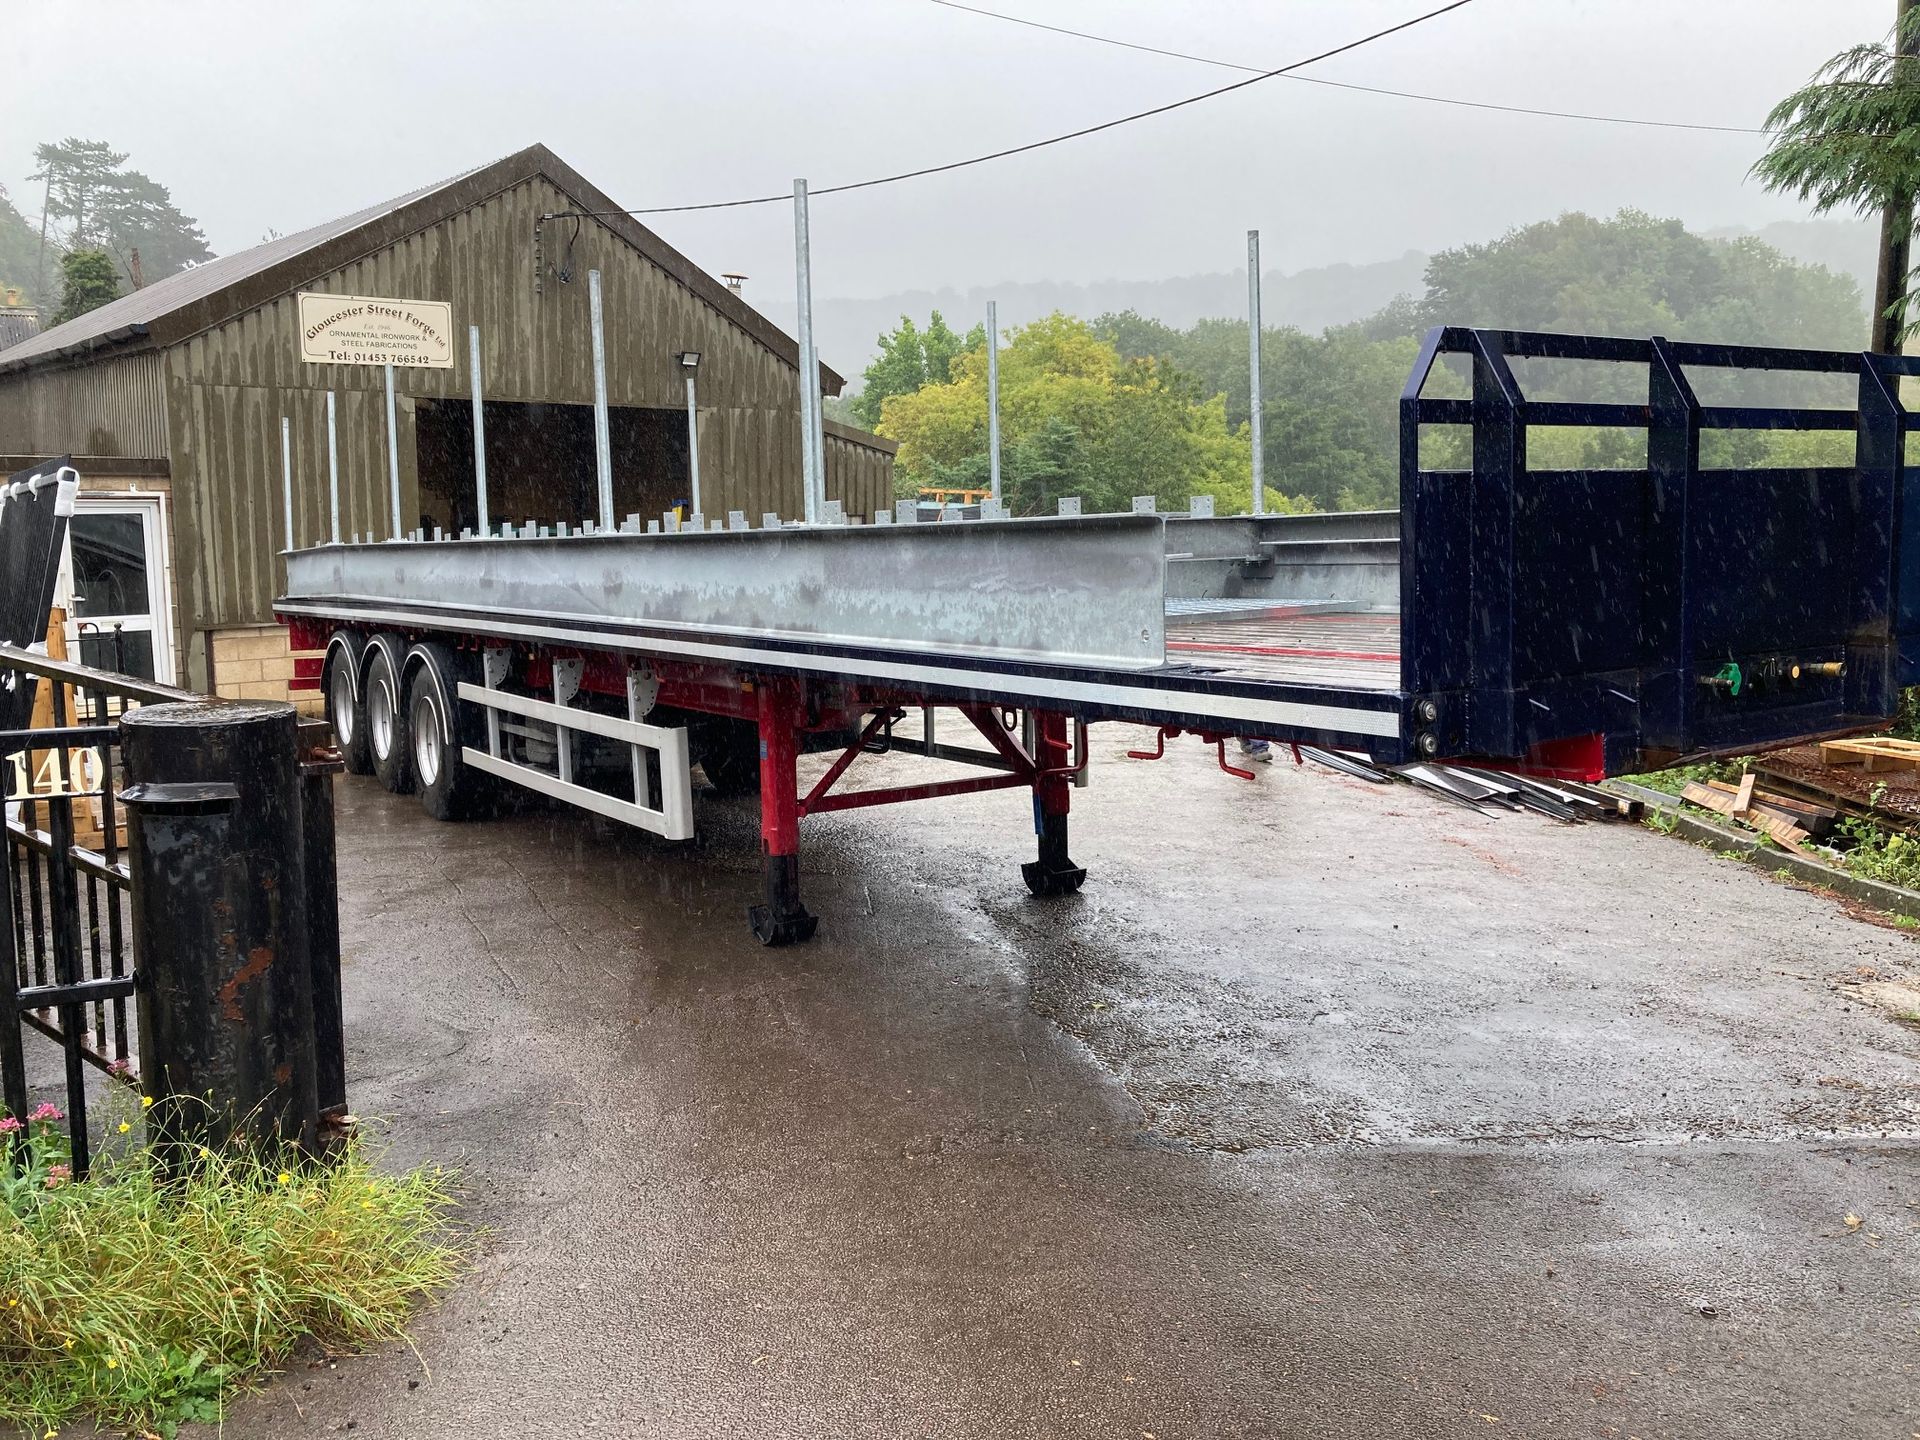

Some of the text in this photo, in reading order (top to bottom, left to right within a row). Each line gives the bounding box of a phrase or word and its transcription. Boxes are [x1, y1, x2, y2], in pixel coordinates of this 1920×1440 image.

[306, 304, 446, 348] Gloucester Street Forge Ltd
[329, 330, 379, 339] ORNAMENTAL
[381, 333, 420, 341] IRONWORK
[341, 339, 418, 350] STEEL FABRICATIONS
[329, 350, 429, 364] Tel: 01453 766542
[5, 747, 104, 799] 140
